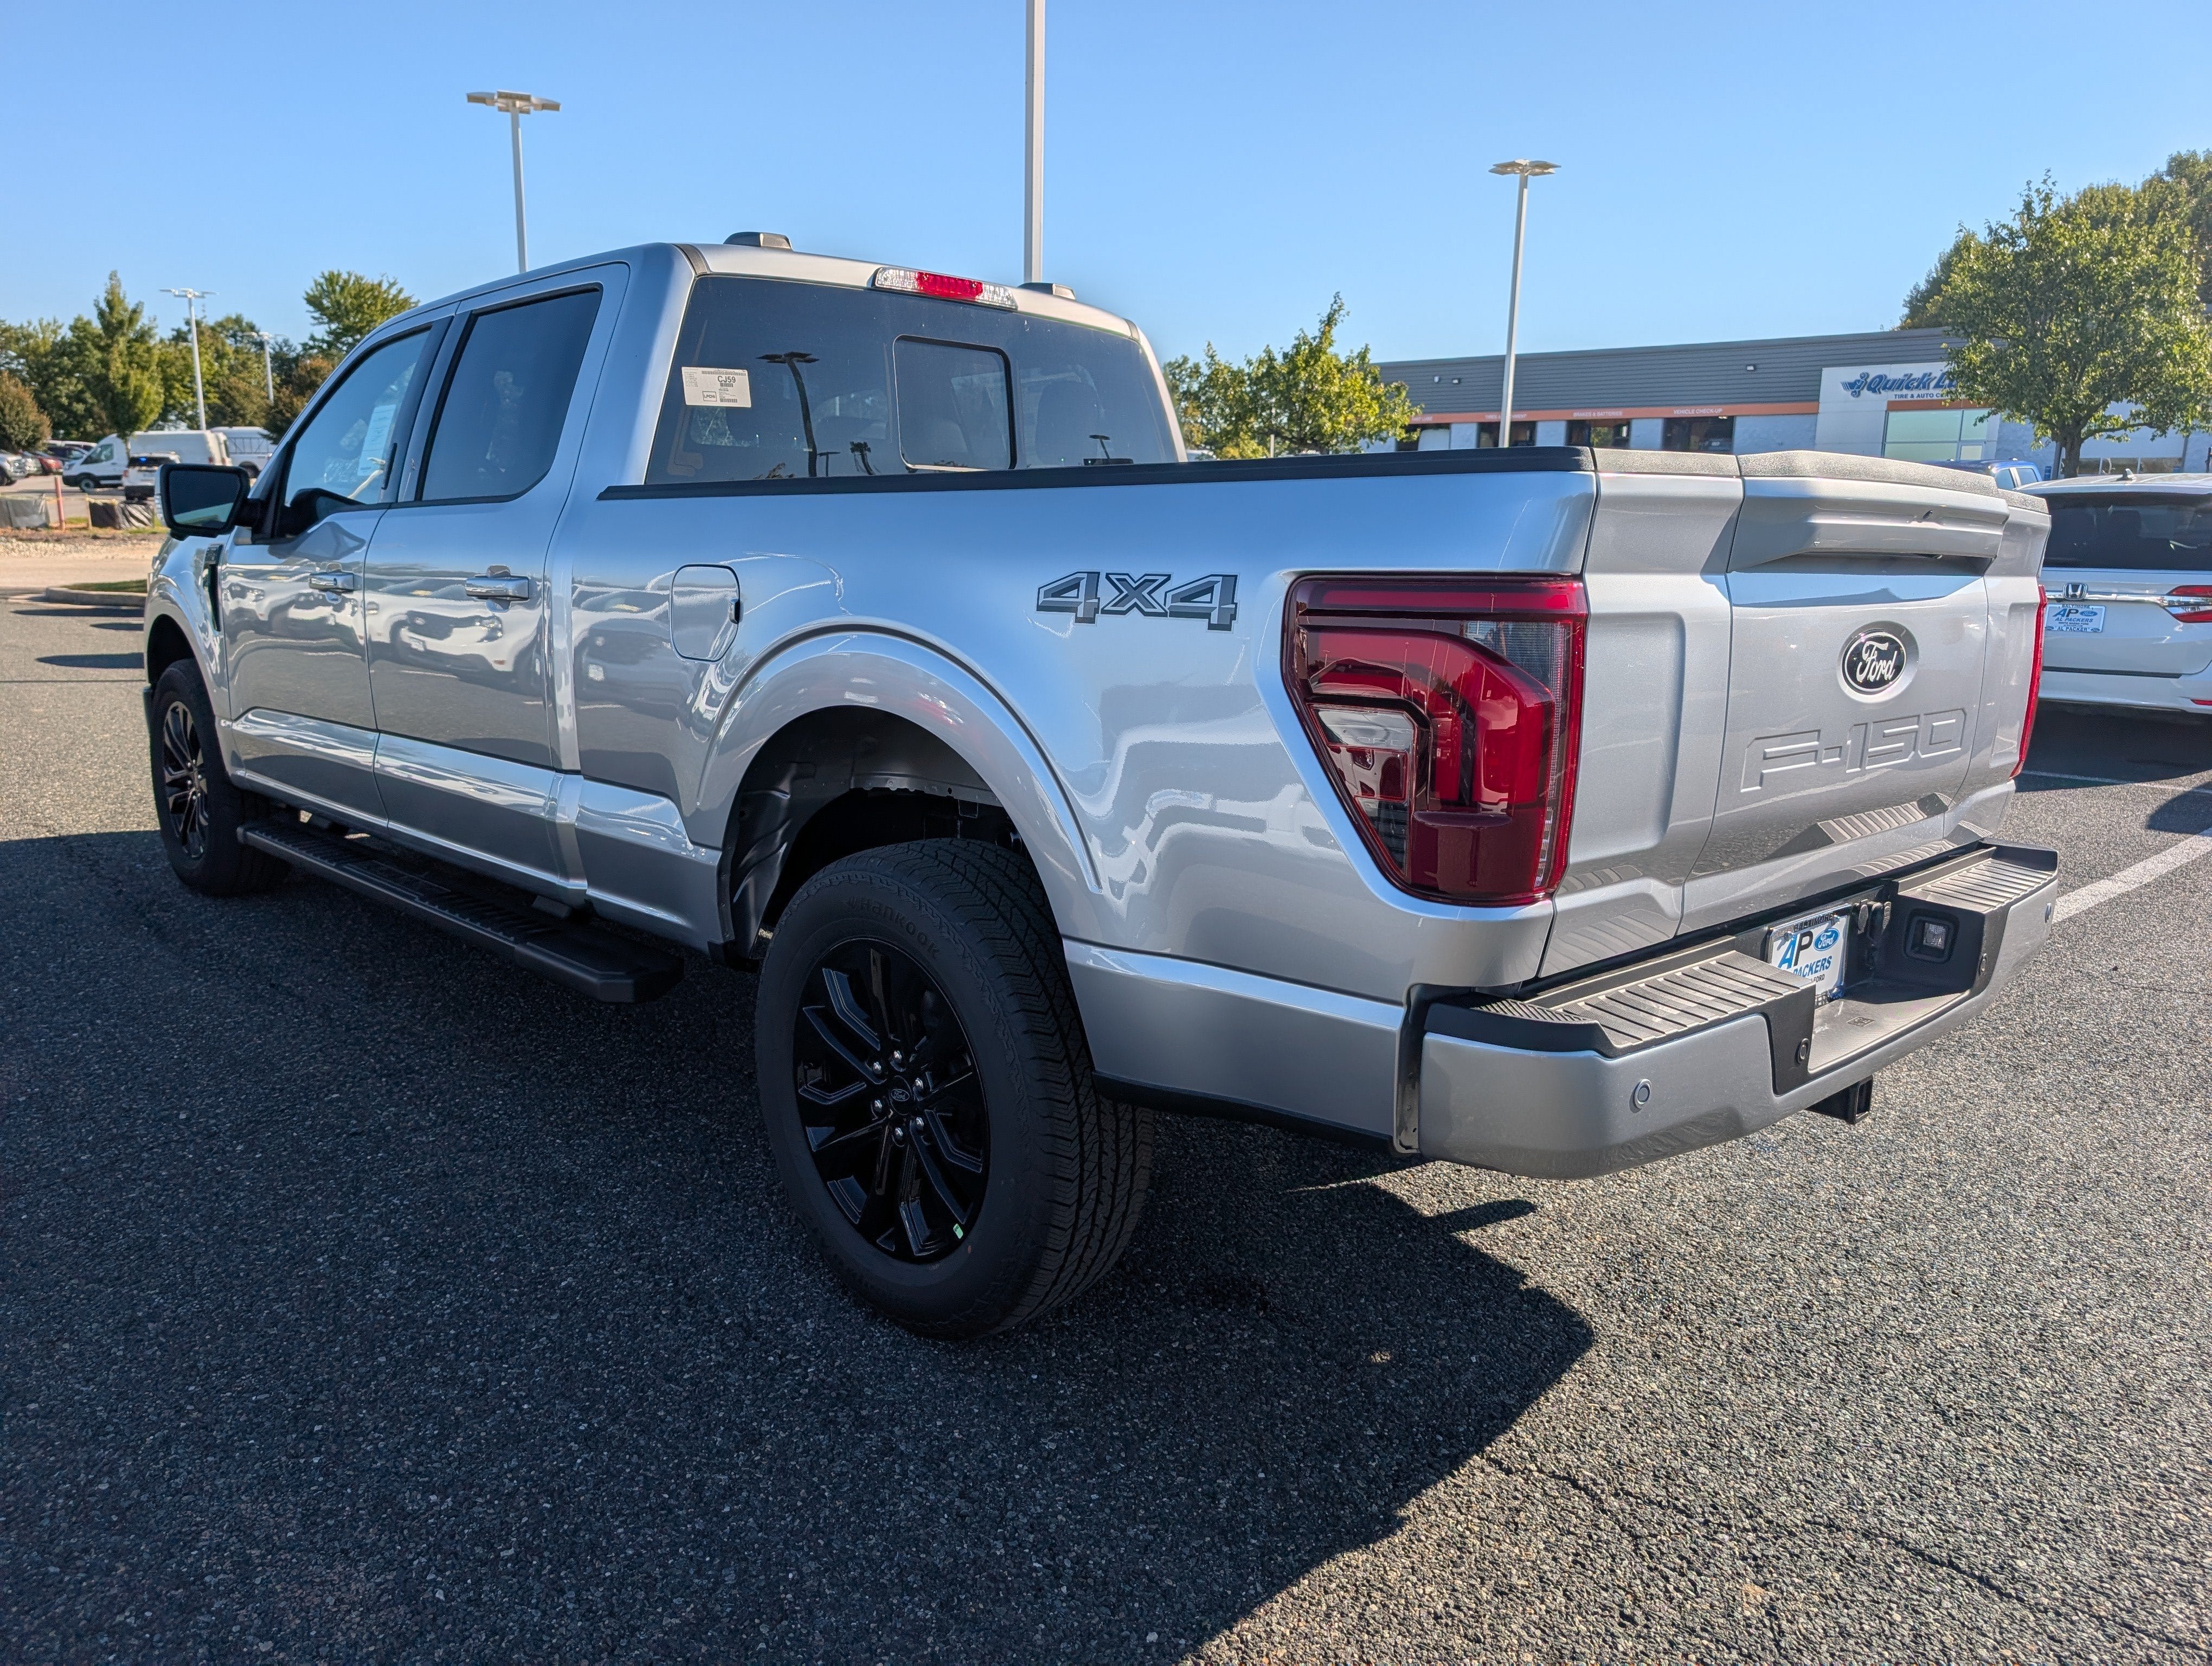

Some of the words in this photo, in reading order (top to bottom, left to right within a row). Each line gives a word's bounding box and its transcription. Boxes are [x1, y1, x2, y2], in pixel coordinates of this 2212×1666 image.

[717, 375, 736, 383] CJ59
[1867, 372, 1936, 394] Quick
[1036, 571, 1239, 632] 4X4
[2053, 608, 2079, 618] AP
[1856, 640, 1898, 682] Ford
[1740, 707, 1967, 793] F-150
[1793, 913, 1834, 932] BALTIMORE
[1778, 931, 1814, 969] AP
[1793, 955, 1832, 978] PACKERS
